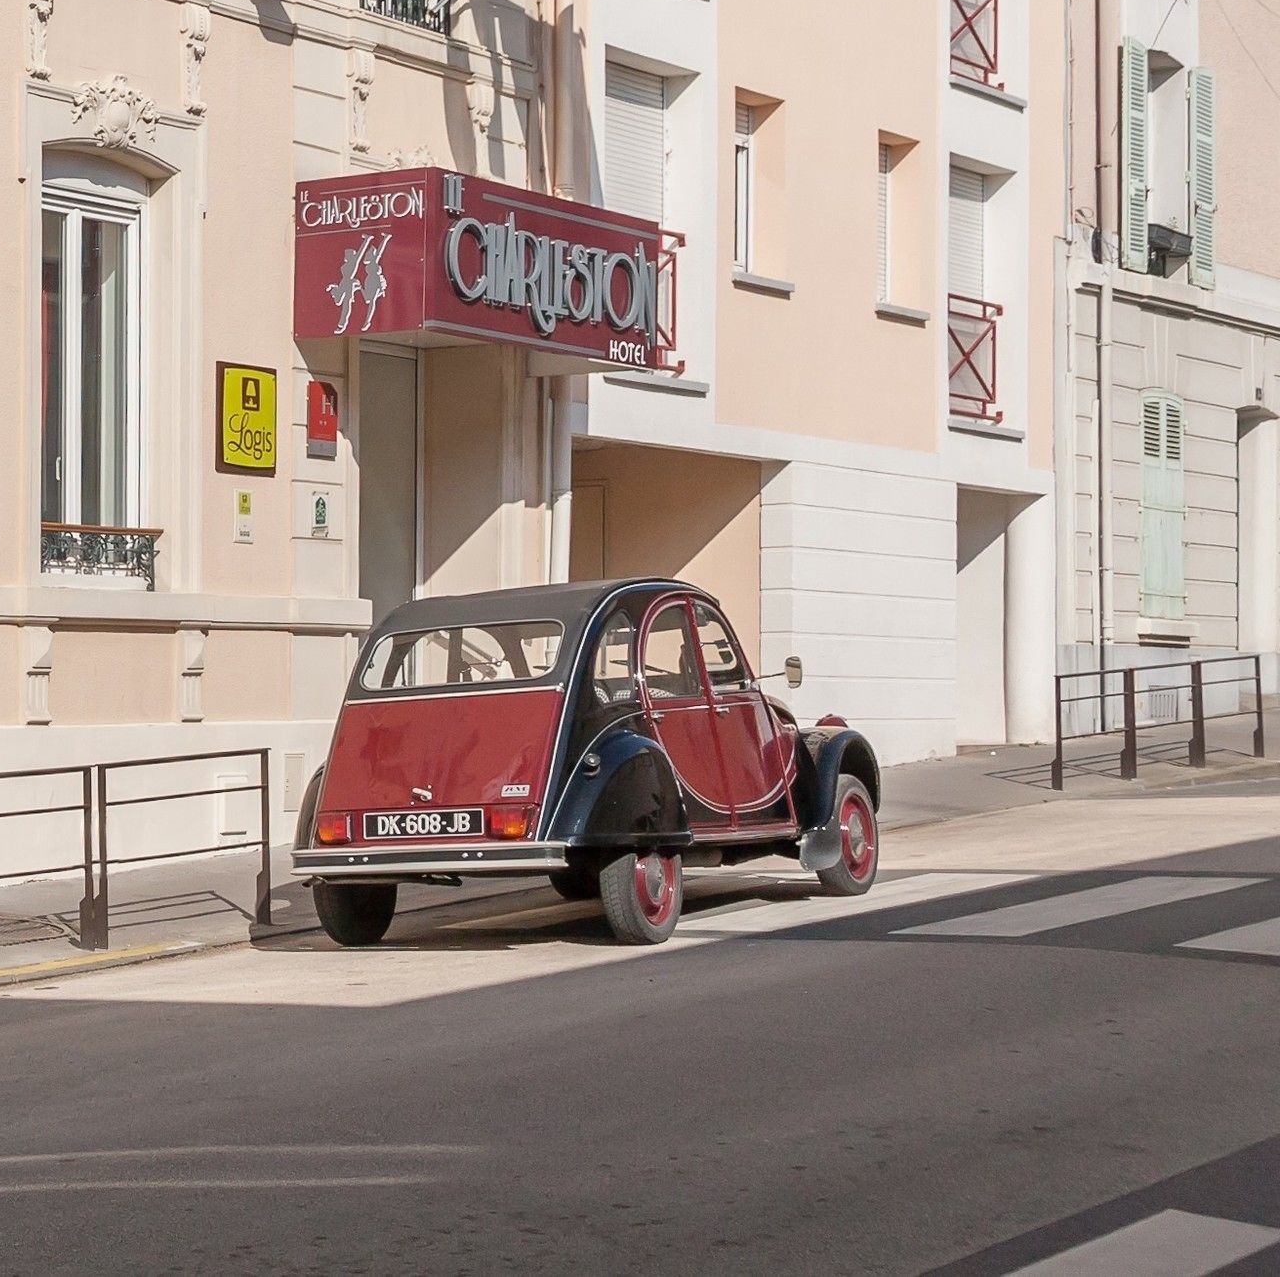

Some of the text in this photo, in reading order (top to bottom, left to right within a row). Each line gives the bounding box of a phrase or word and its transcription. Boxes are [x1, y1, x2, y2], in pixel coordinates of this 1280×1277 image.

[300, 190, 309, 203] LE
[302, 187, 423, 228] CHARLESTON
[445, 212, 656, 350] CHARLESTON
[609, 339, 646, 365] HOTEL
[322, 394, 335, 415] H
[228, 412, 272, 460] Logis
[377, 813, 471, 835] DK-608-JB
